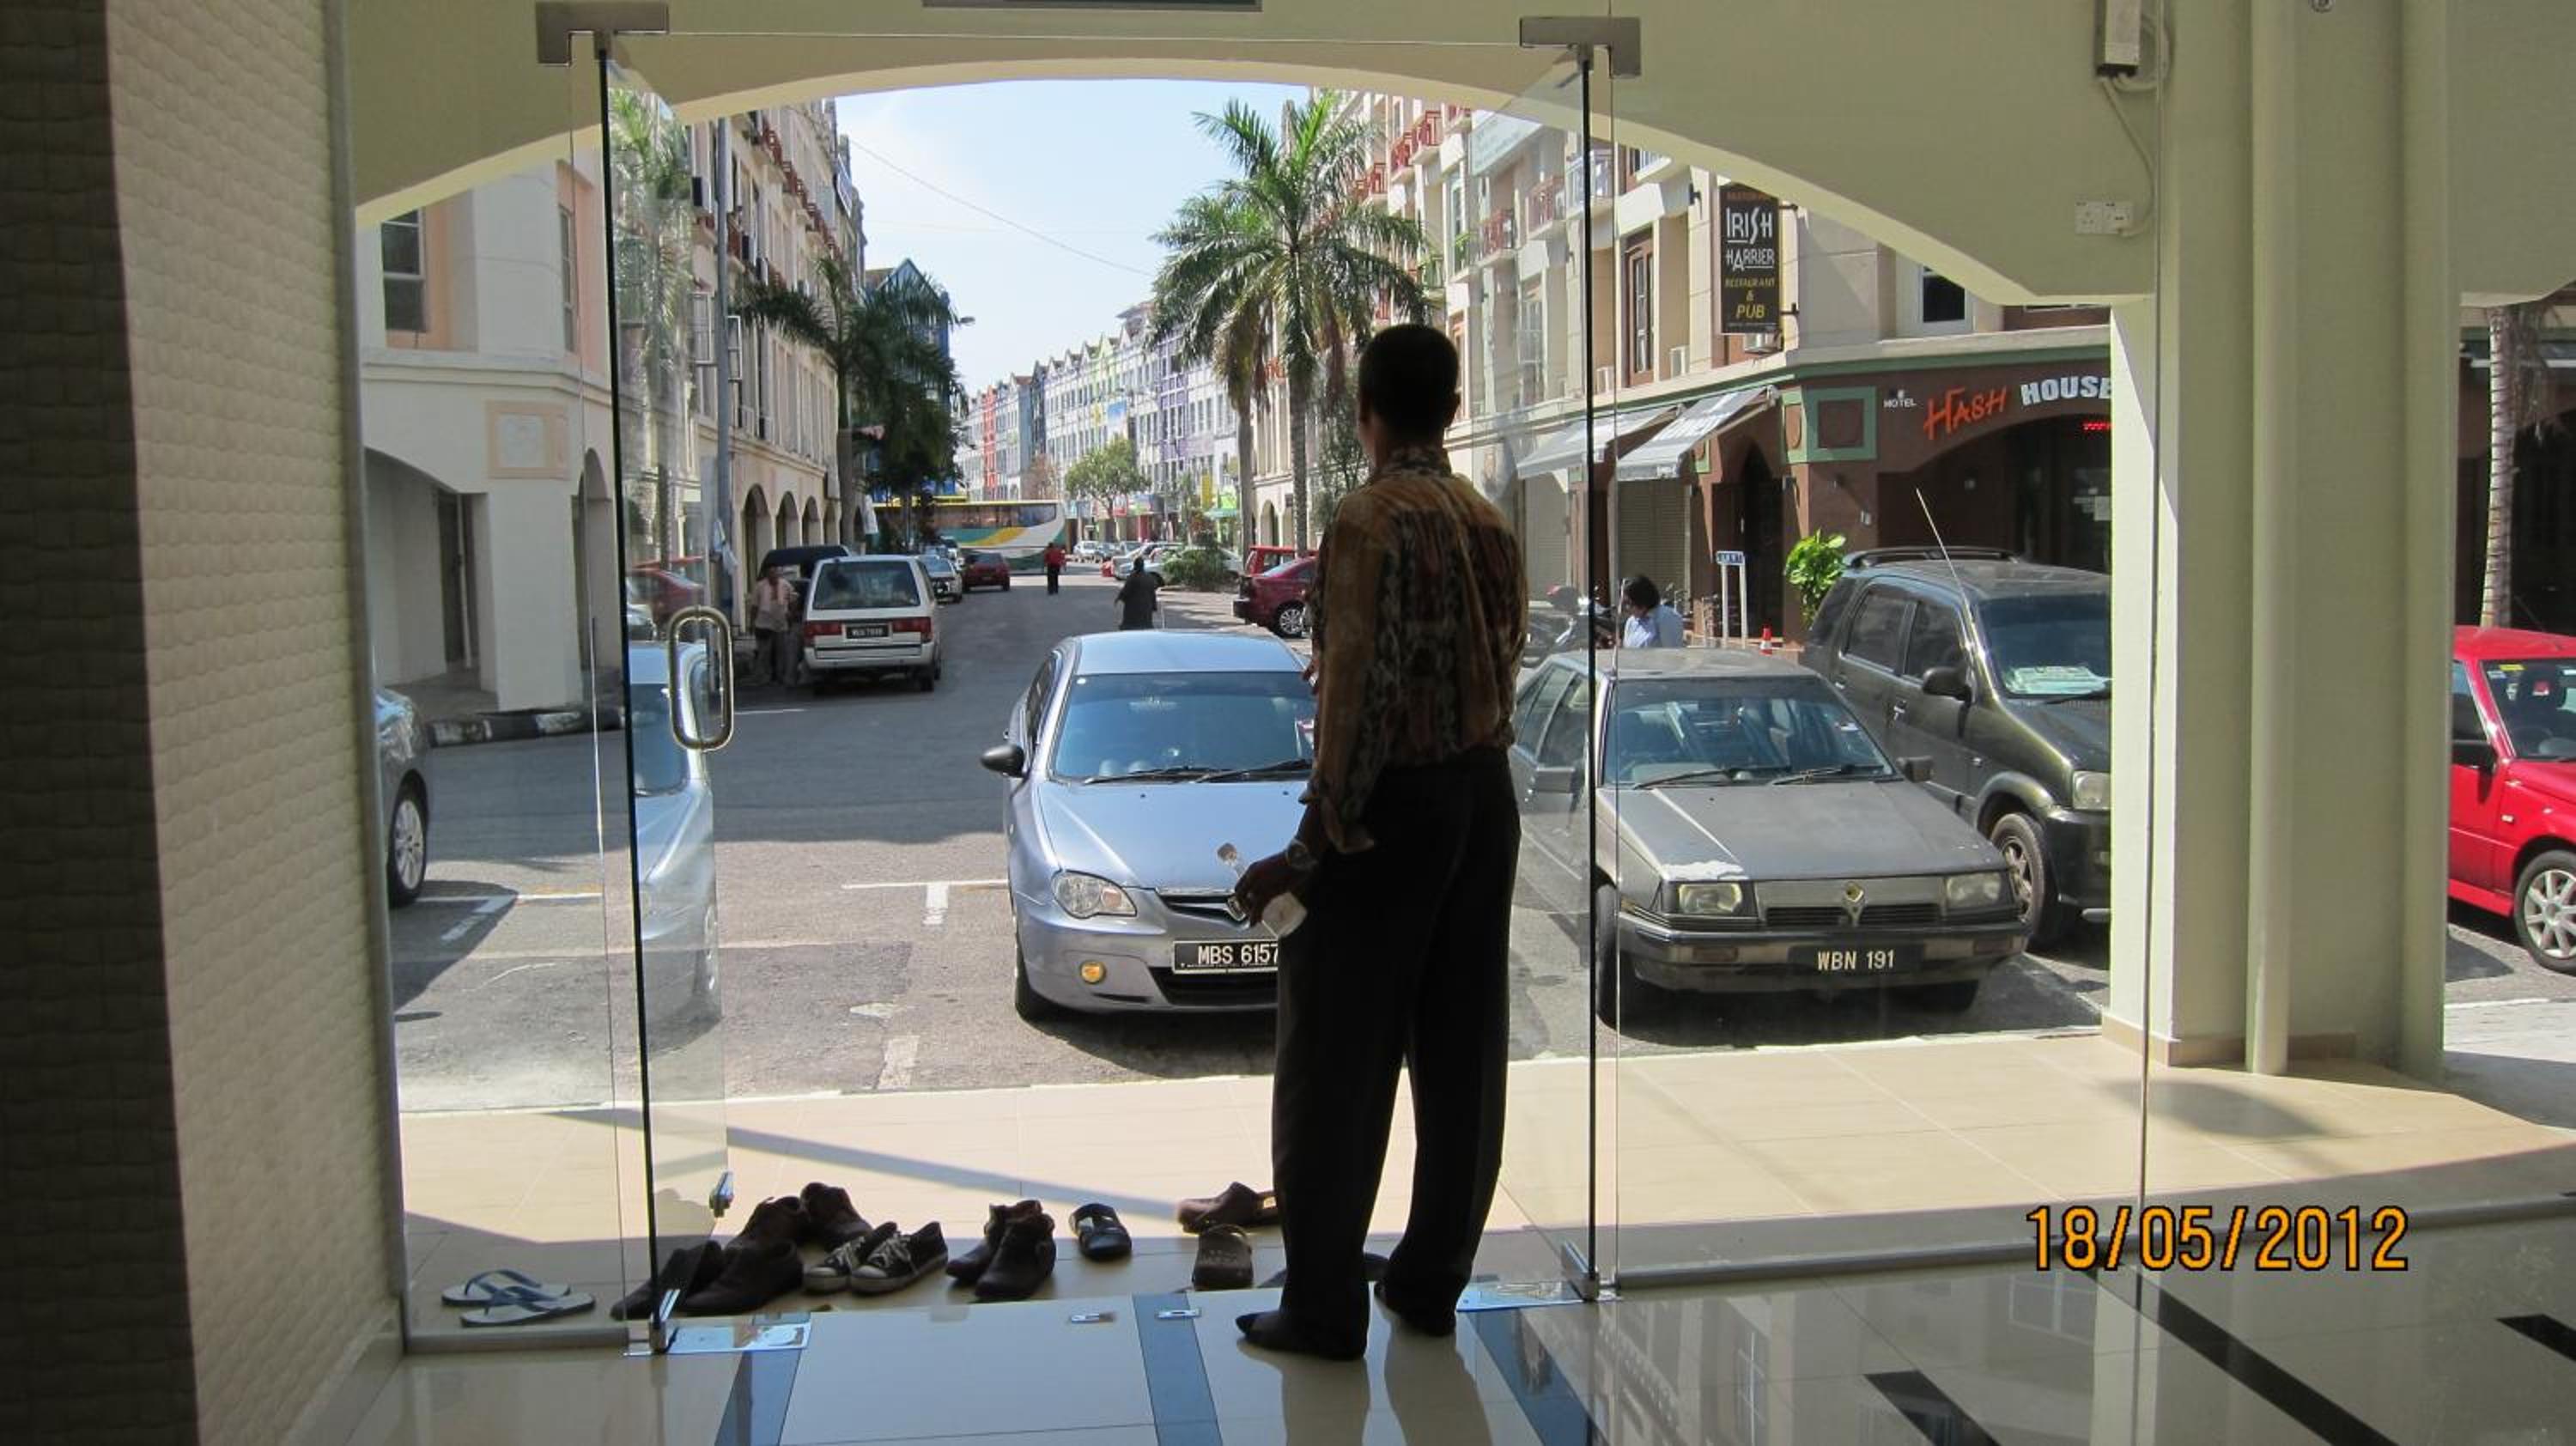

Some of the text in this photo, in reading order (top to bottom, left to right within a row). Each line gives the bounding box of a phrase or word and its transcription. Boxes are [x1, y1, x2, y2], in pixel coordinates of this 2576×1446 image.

[1726, 207, 1772, 244] IRISH
[1726, 248, 1775, 271] HARRIER
[1736, 304, 1765, 319] PUB
[1883, 398, 1917, 408] HOTEL
[1923, 387, 2007, 440] HASH
[1198, 944, 1278, 964] MBS 6157
[1818, 949, 1894, 970] WBN 191
